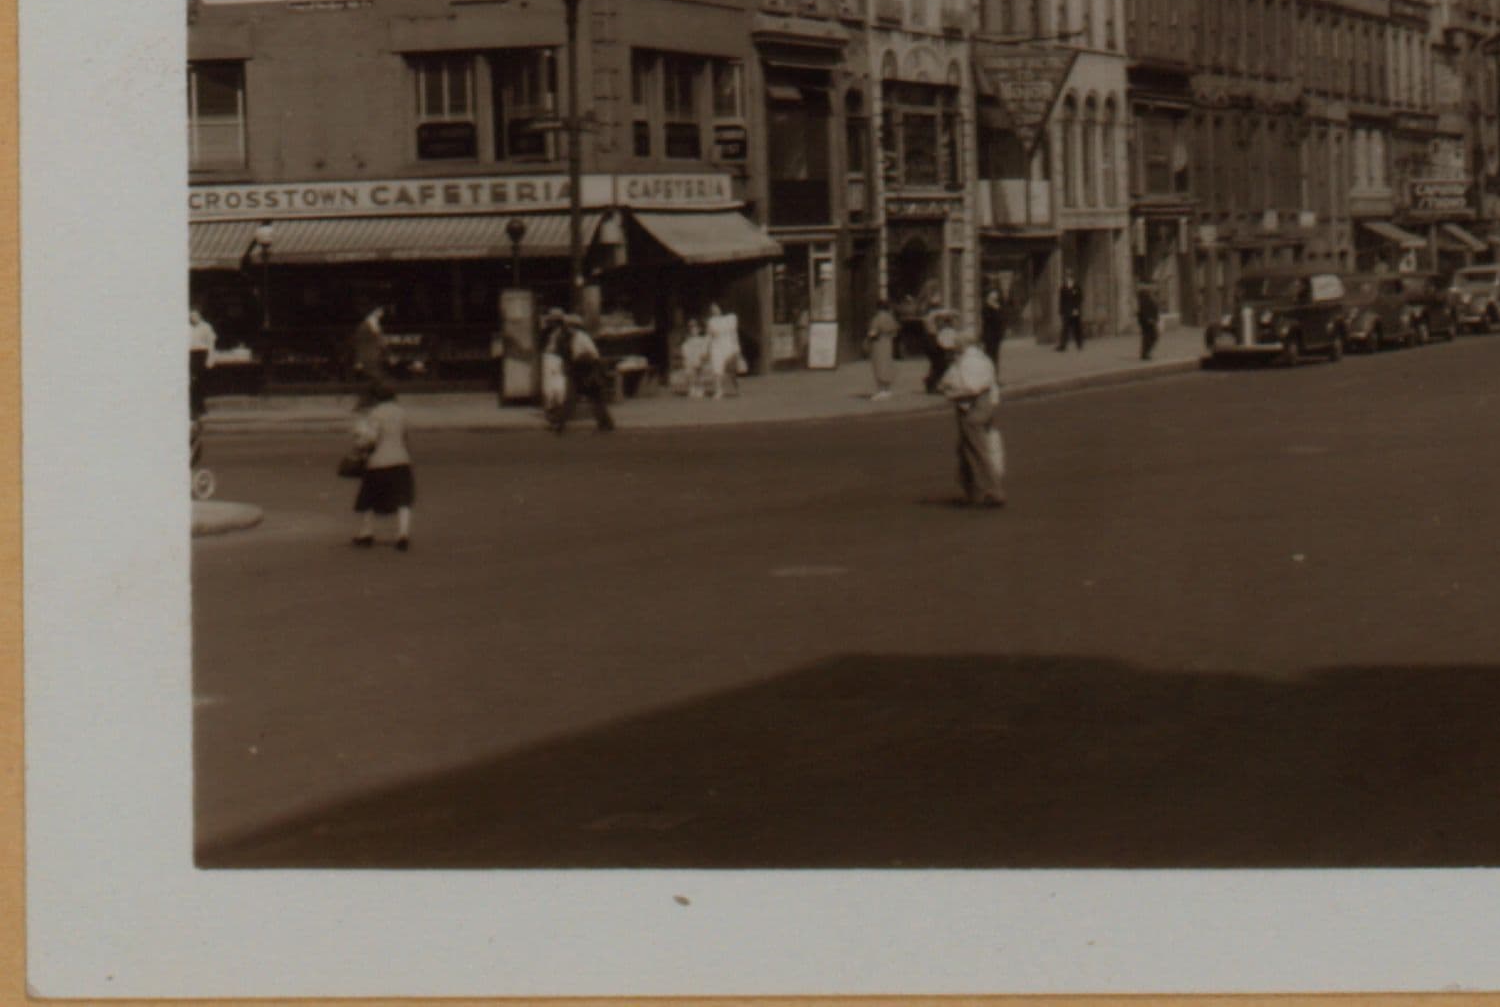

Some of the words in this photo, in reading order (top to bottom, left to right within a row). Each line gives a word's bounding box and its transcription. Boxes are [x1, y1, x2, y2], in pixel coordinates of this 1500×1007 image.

[188, 188, 358, 210] CROSSTOWN
[370, 182, 572, 207] CAFETERIA
[627, 179, 724, 199] CAFETERIA
